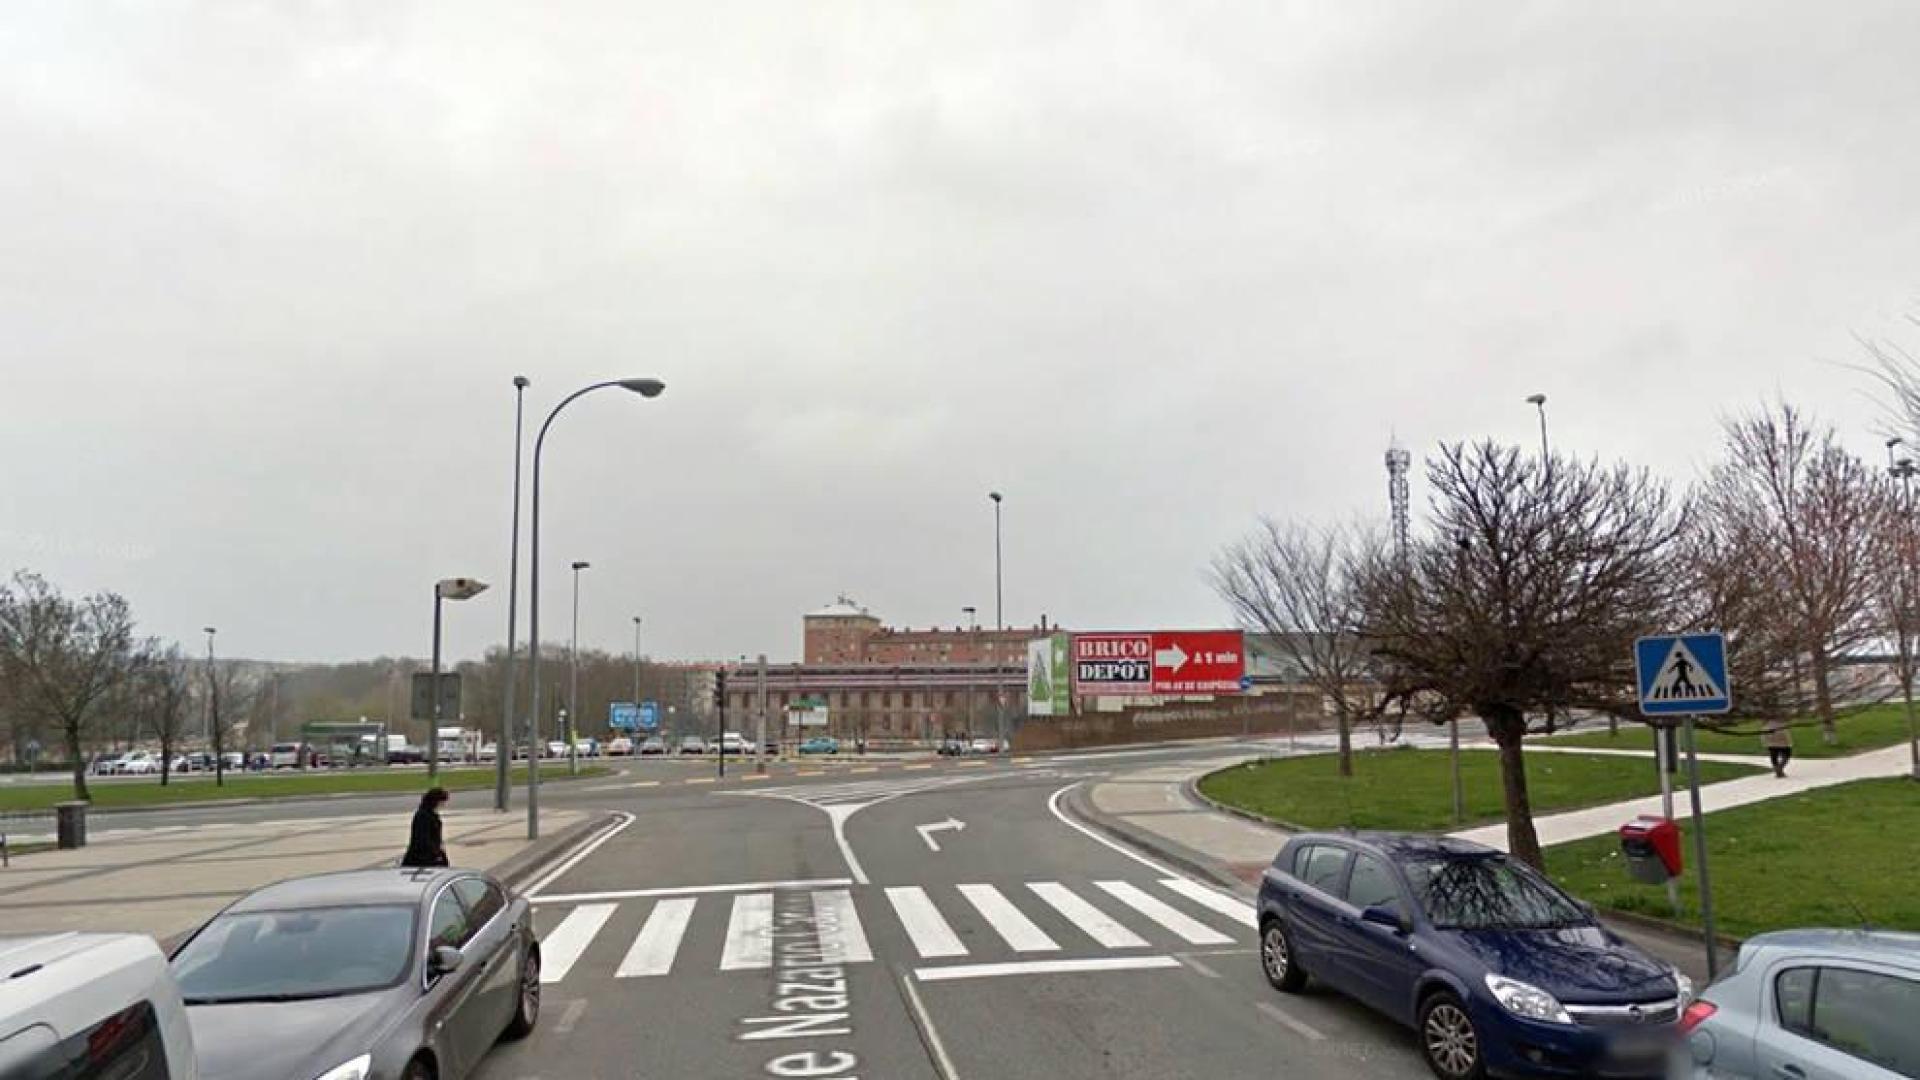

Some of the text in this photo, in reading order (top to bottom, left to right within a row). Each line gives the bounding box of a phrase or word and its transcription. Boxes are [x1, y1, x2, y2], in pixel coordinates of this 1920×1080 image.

[1080, 640, 1147, 656] BRICO
[1215, 651, 1238, 664] min
[1080, 657, 1149, 680] DEPÔT
